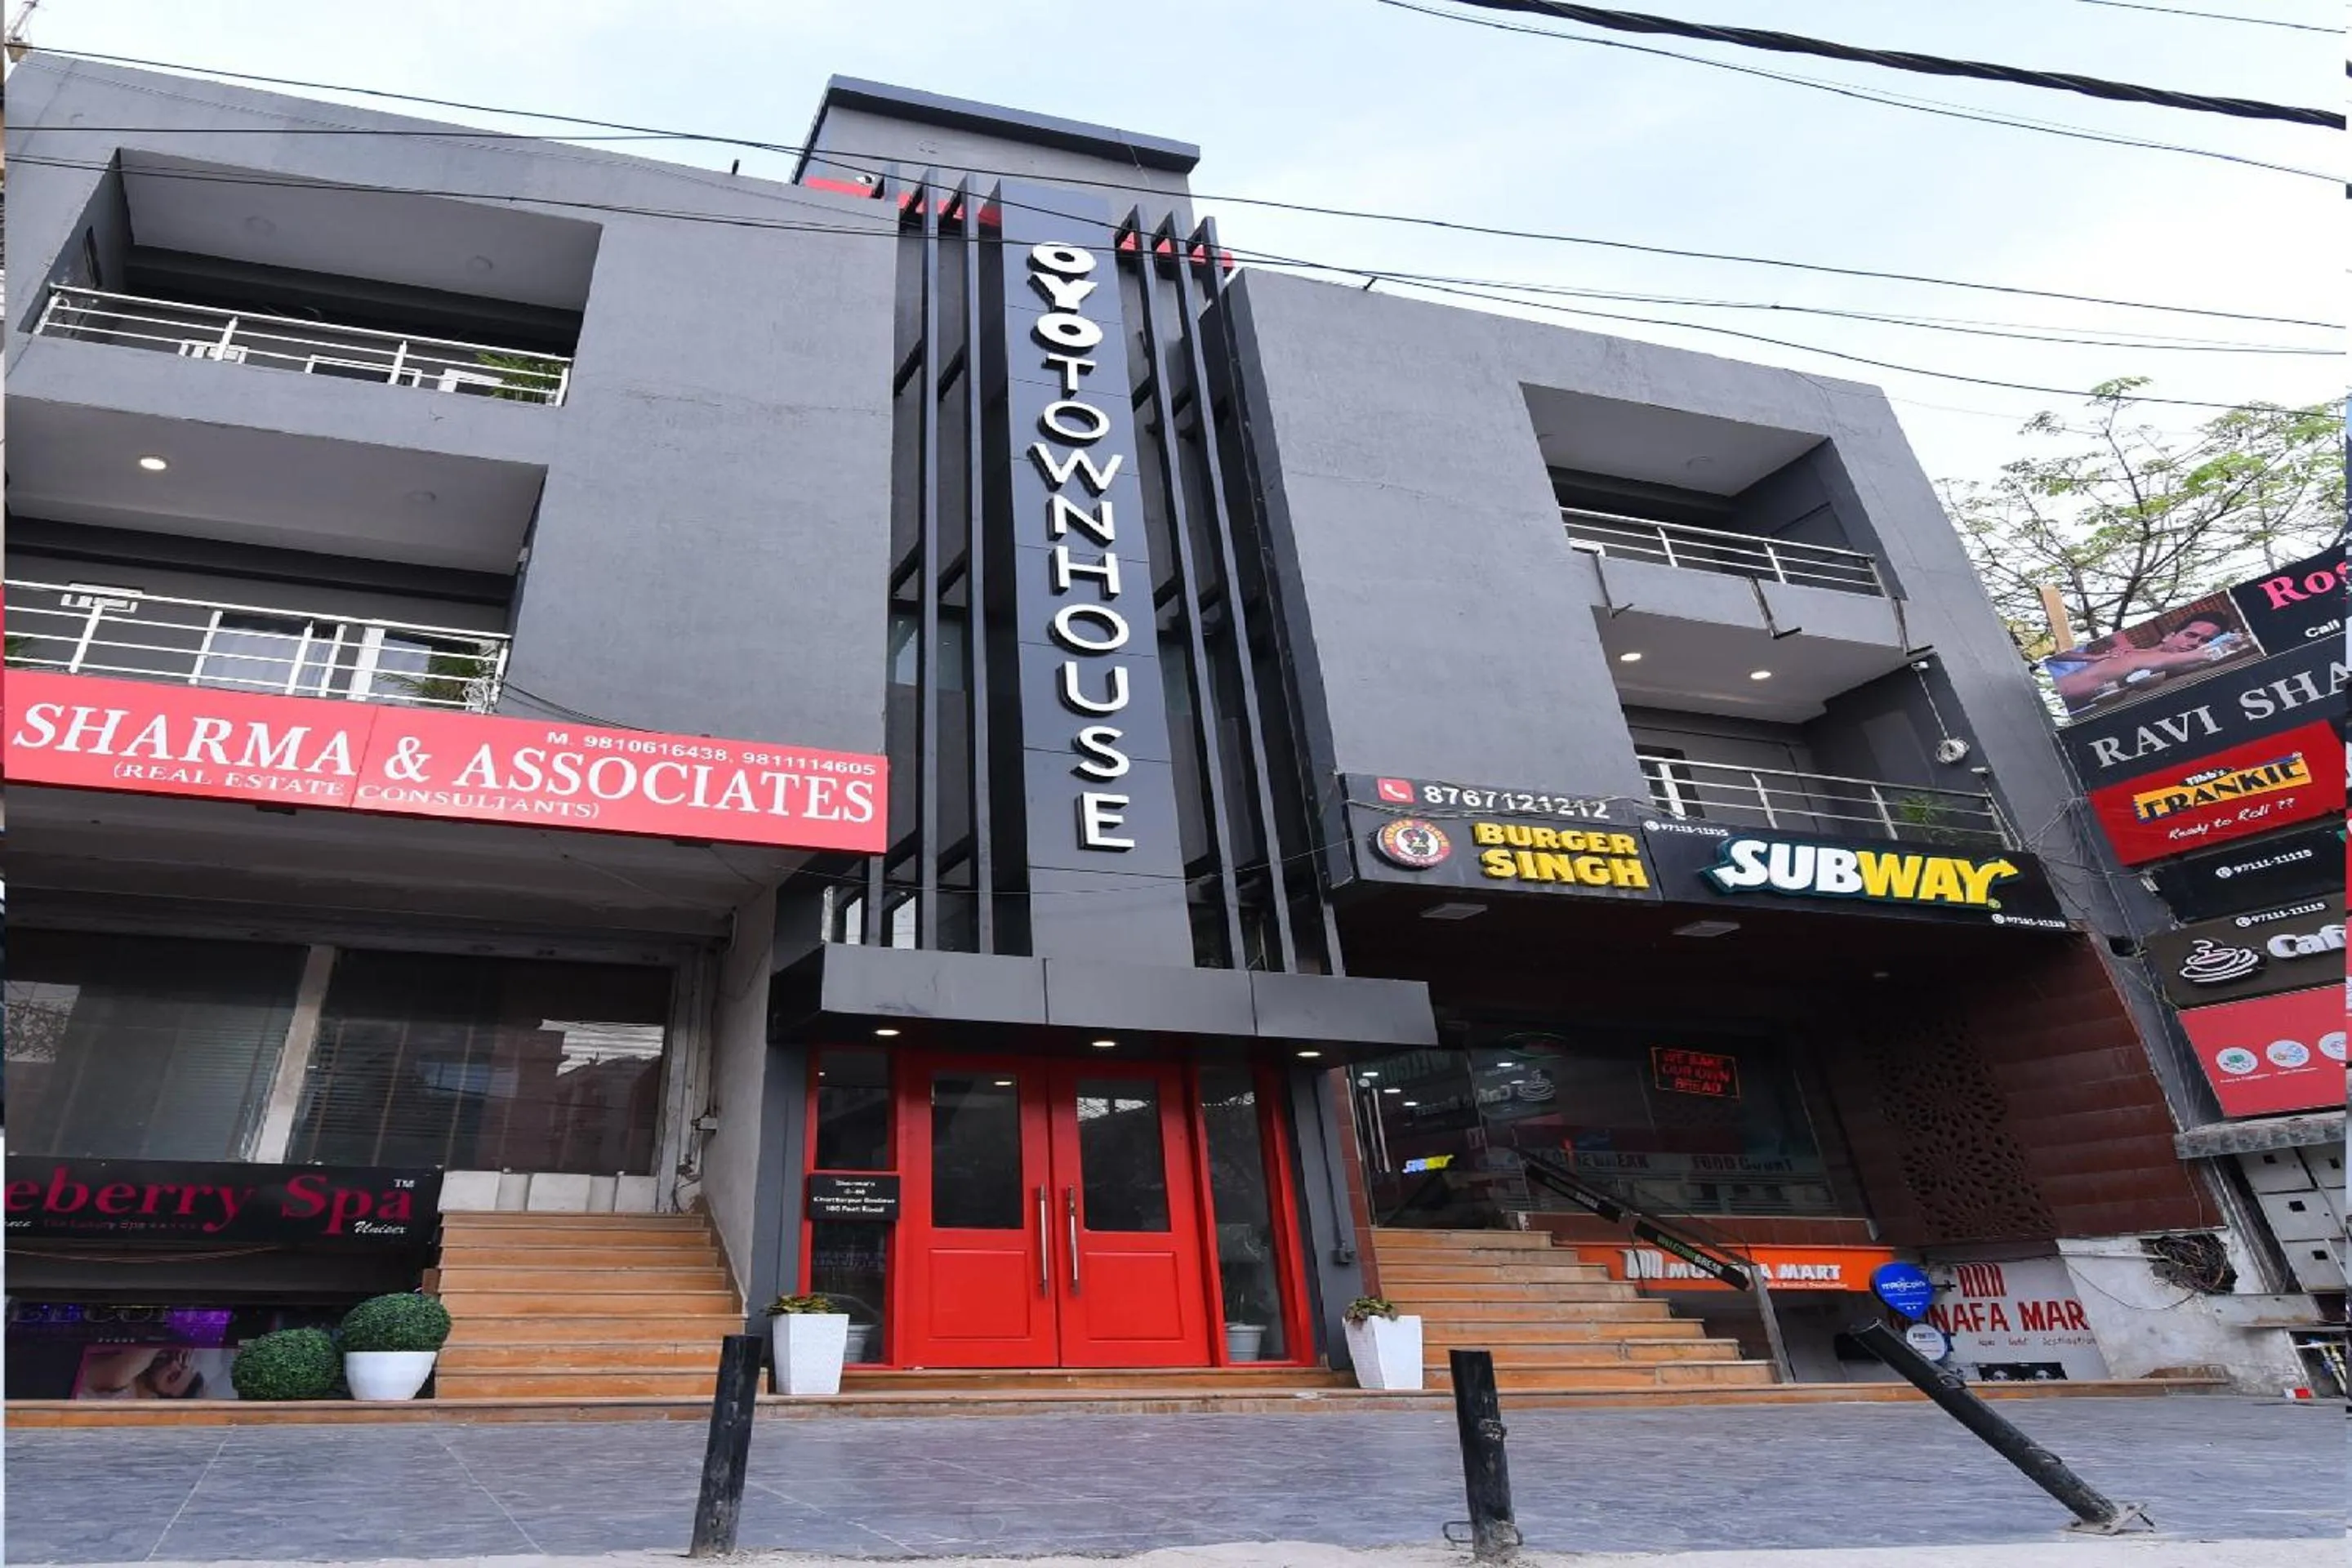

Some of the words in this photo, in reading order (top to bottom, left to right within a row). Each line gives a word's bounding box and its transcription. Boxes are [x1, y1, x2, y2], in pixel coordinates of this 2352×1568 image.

[1031, 242, 1102, 347] OYO
[2305, 619, 2341, 637] Call
[2088, 706, 2223, 768] RAVI
[13, 703, 356, 777] SHARMA
[385, 736, 434, 783] &
[452, 743, 874, 823] ASSOCIATES
[742, 751, 876, 776] 9811114605
[225, 774, 344, 796] ESTATE
[358, 785, 599, 819] CONSULTANTS)
[1423, 786, 1610, 819] 8767121212
[1473, 822, 1639, 856] BURGER
[1480, 849, 1650, 889] SINGH
[1712, 839, 2019, 904] SUBWAY
[2267, 924, 2345, 958] Caf
[282, 1174, 412, 1235] Spa
[1668, 1263, 1774, 1280] MUA
[1779, 1263, 1841, 1281] MART
[1888, 1302, 2011, 1336] MNAFA
